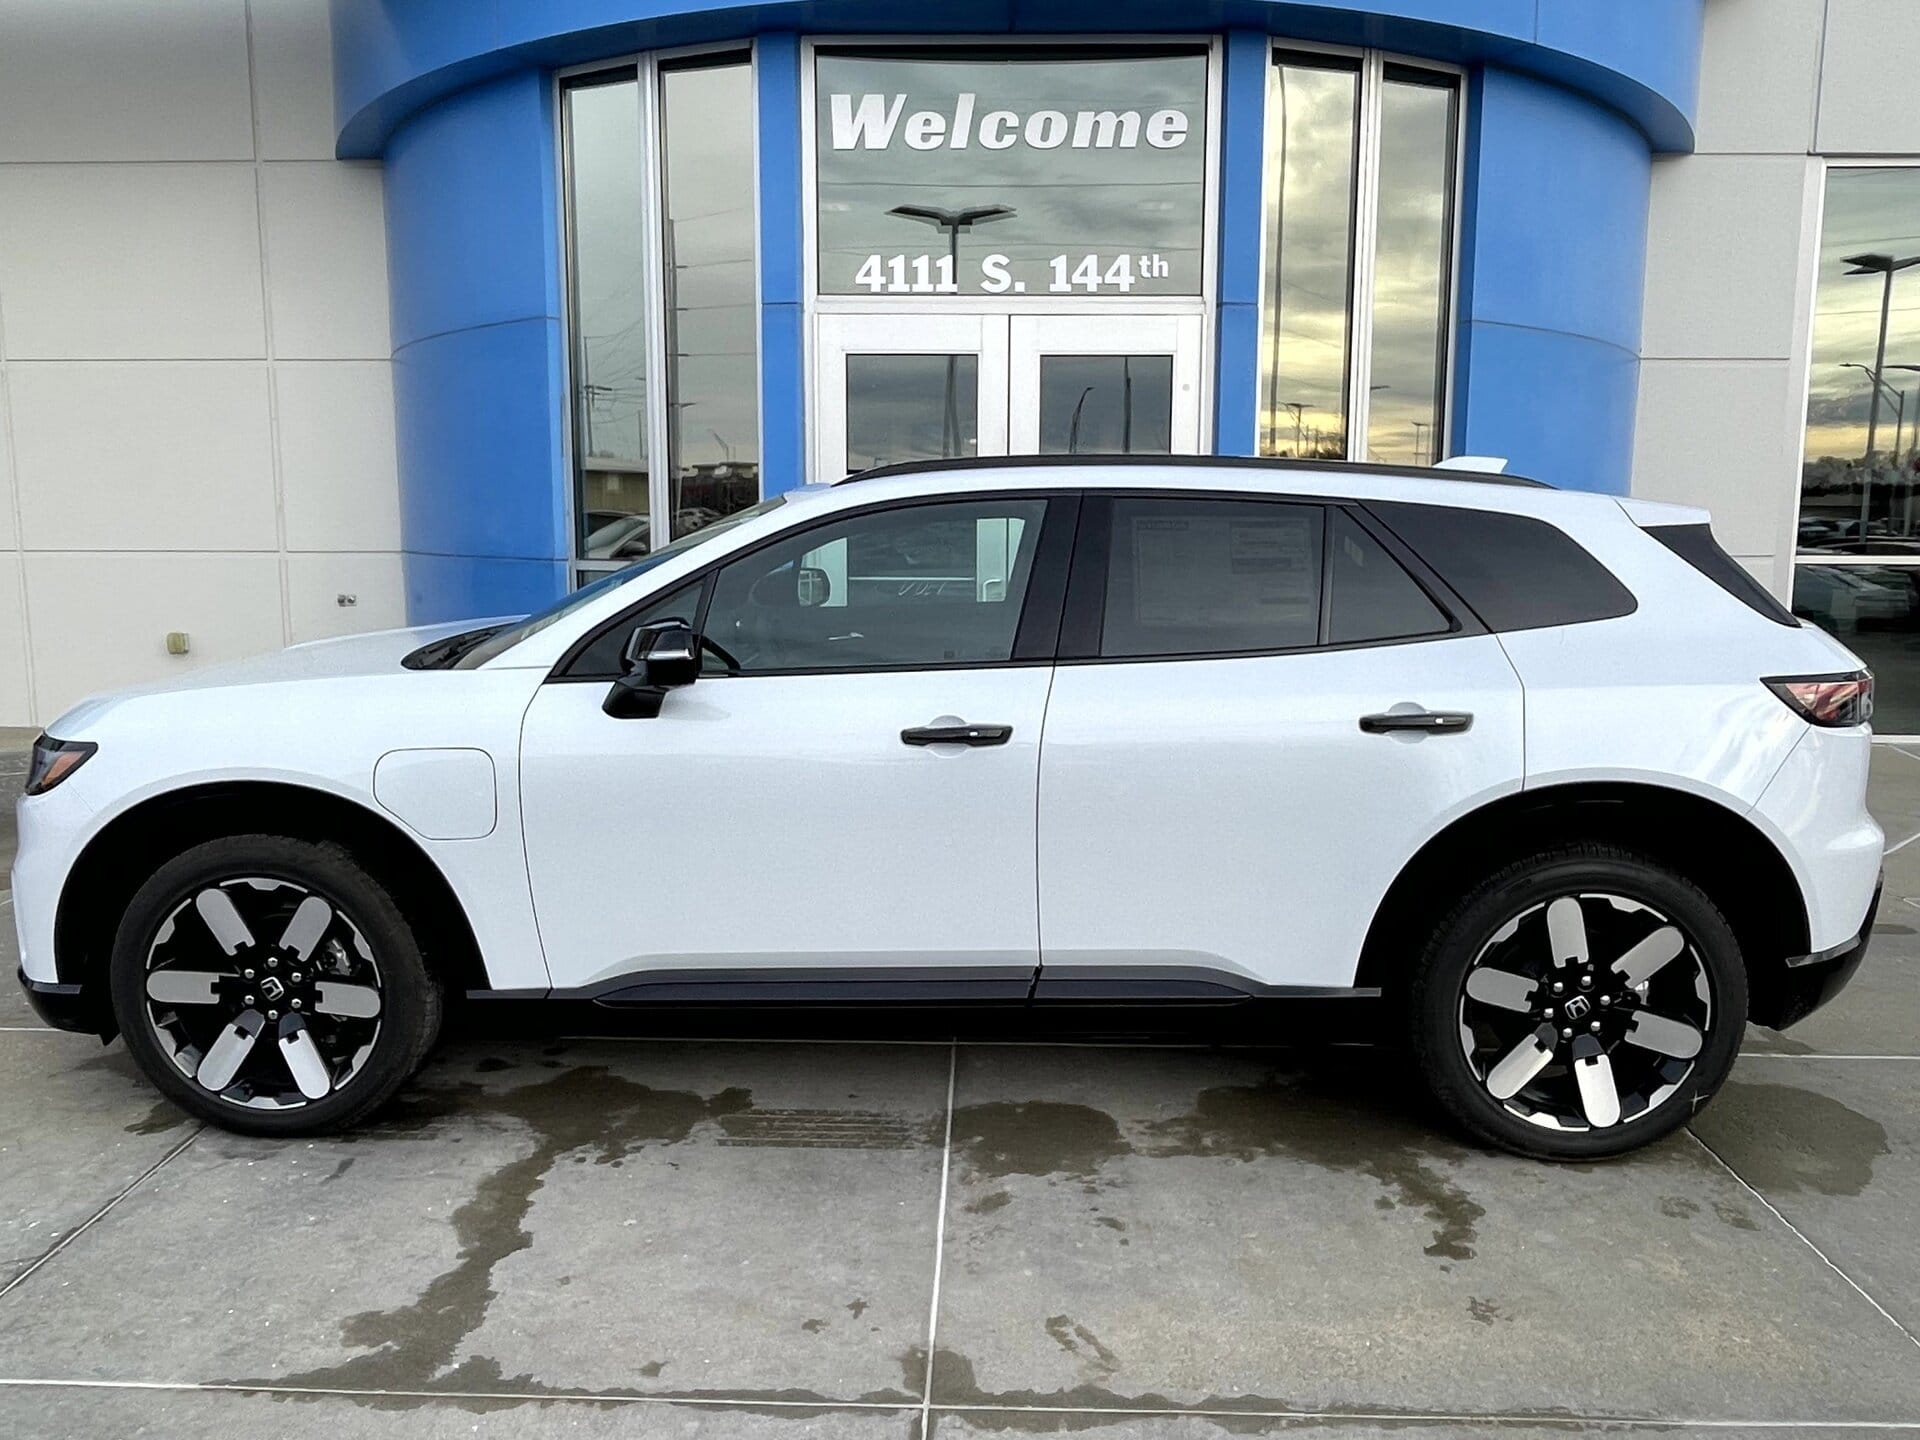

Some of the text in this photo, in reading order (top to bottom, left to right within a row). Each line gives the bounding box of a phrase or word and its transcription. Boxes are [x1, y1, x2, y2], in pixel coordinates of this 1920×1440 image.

[830, 93, 1189, 151] Welcome
[855, 254, 1169, 293] 4111 S. 144th
